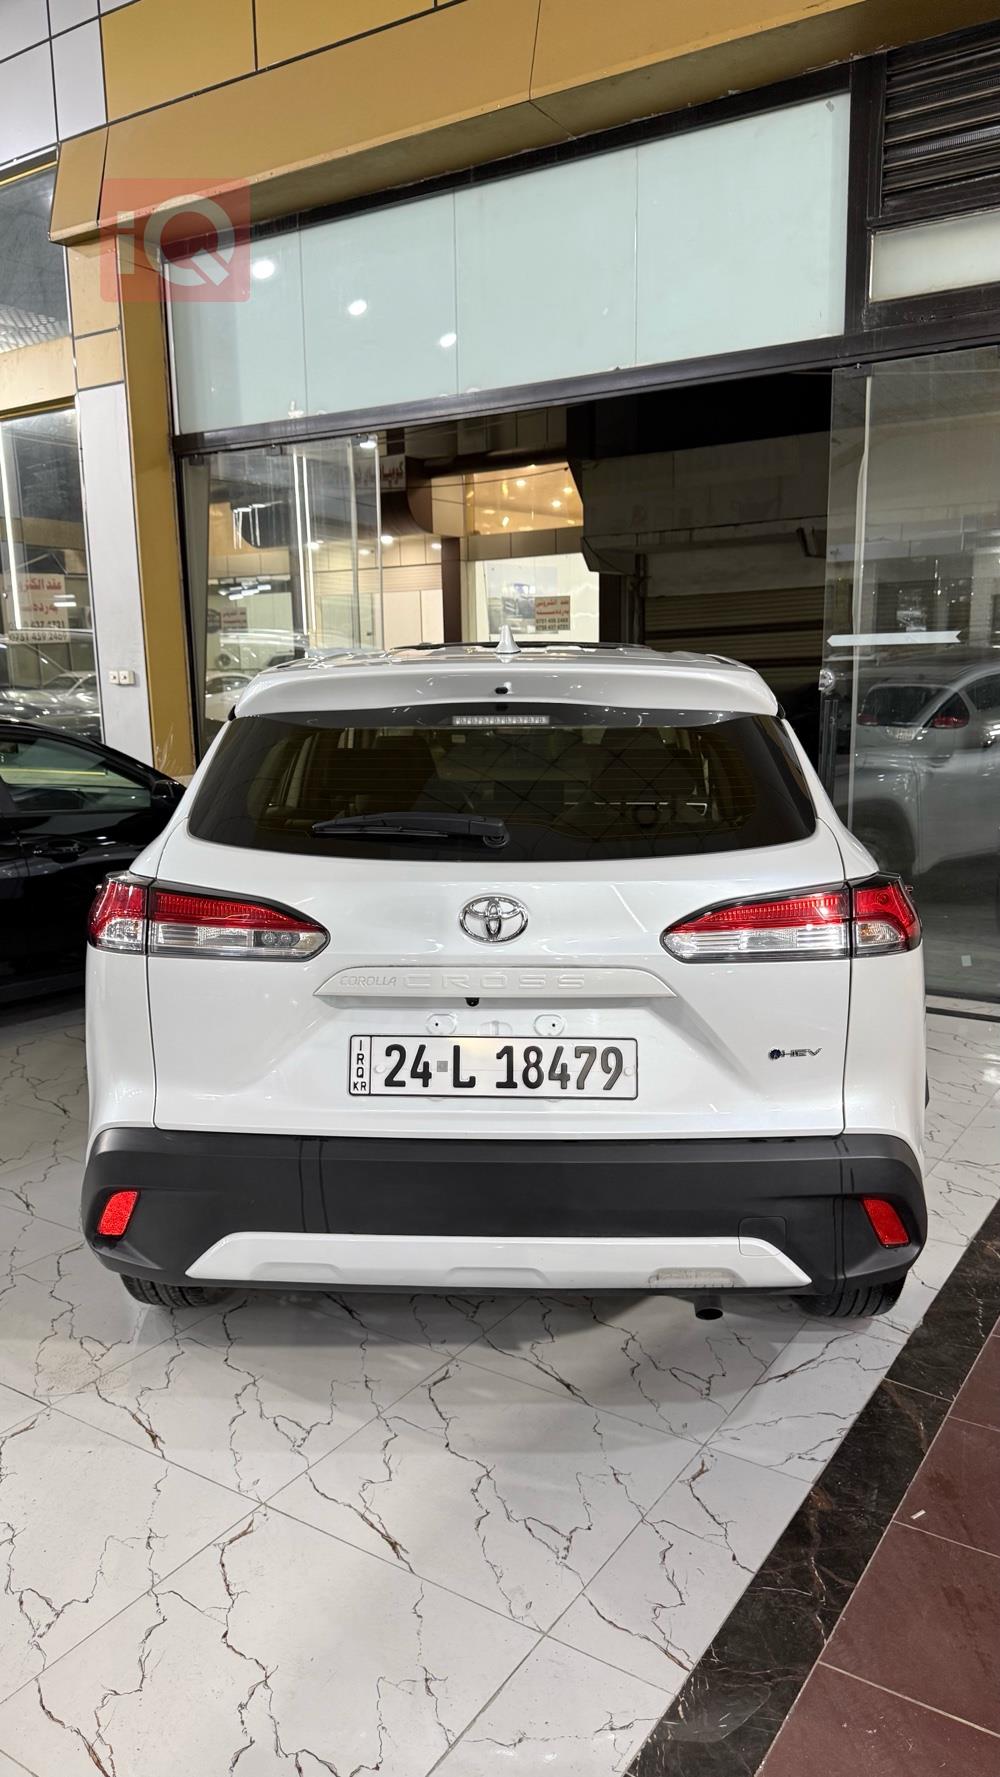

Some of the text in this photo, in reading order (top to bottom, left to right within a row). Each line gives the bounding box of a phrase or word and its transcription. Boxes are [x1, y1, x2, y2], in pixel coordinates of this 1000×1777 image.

[339, 973, 585, 990] COROLLA CROSS
[781, 1047, 823, 1058] HEV
[384, 1043, 624, 1091] 24 L 18479
[353, 1081, 367, 1091] KR
